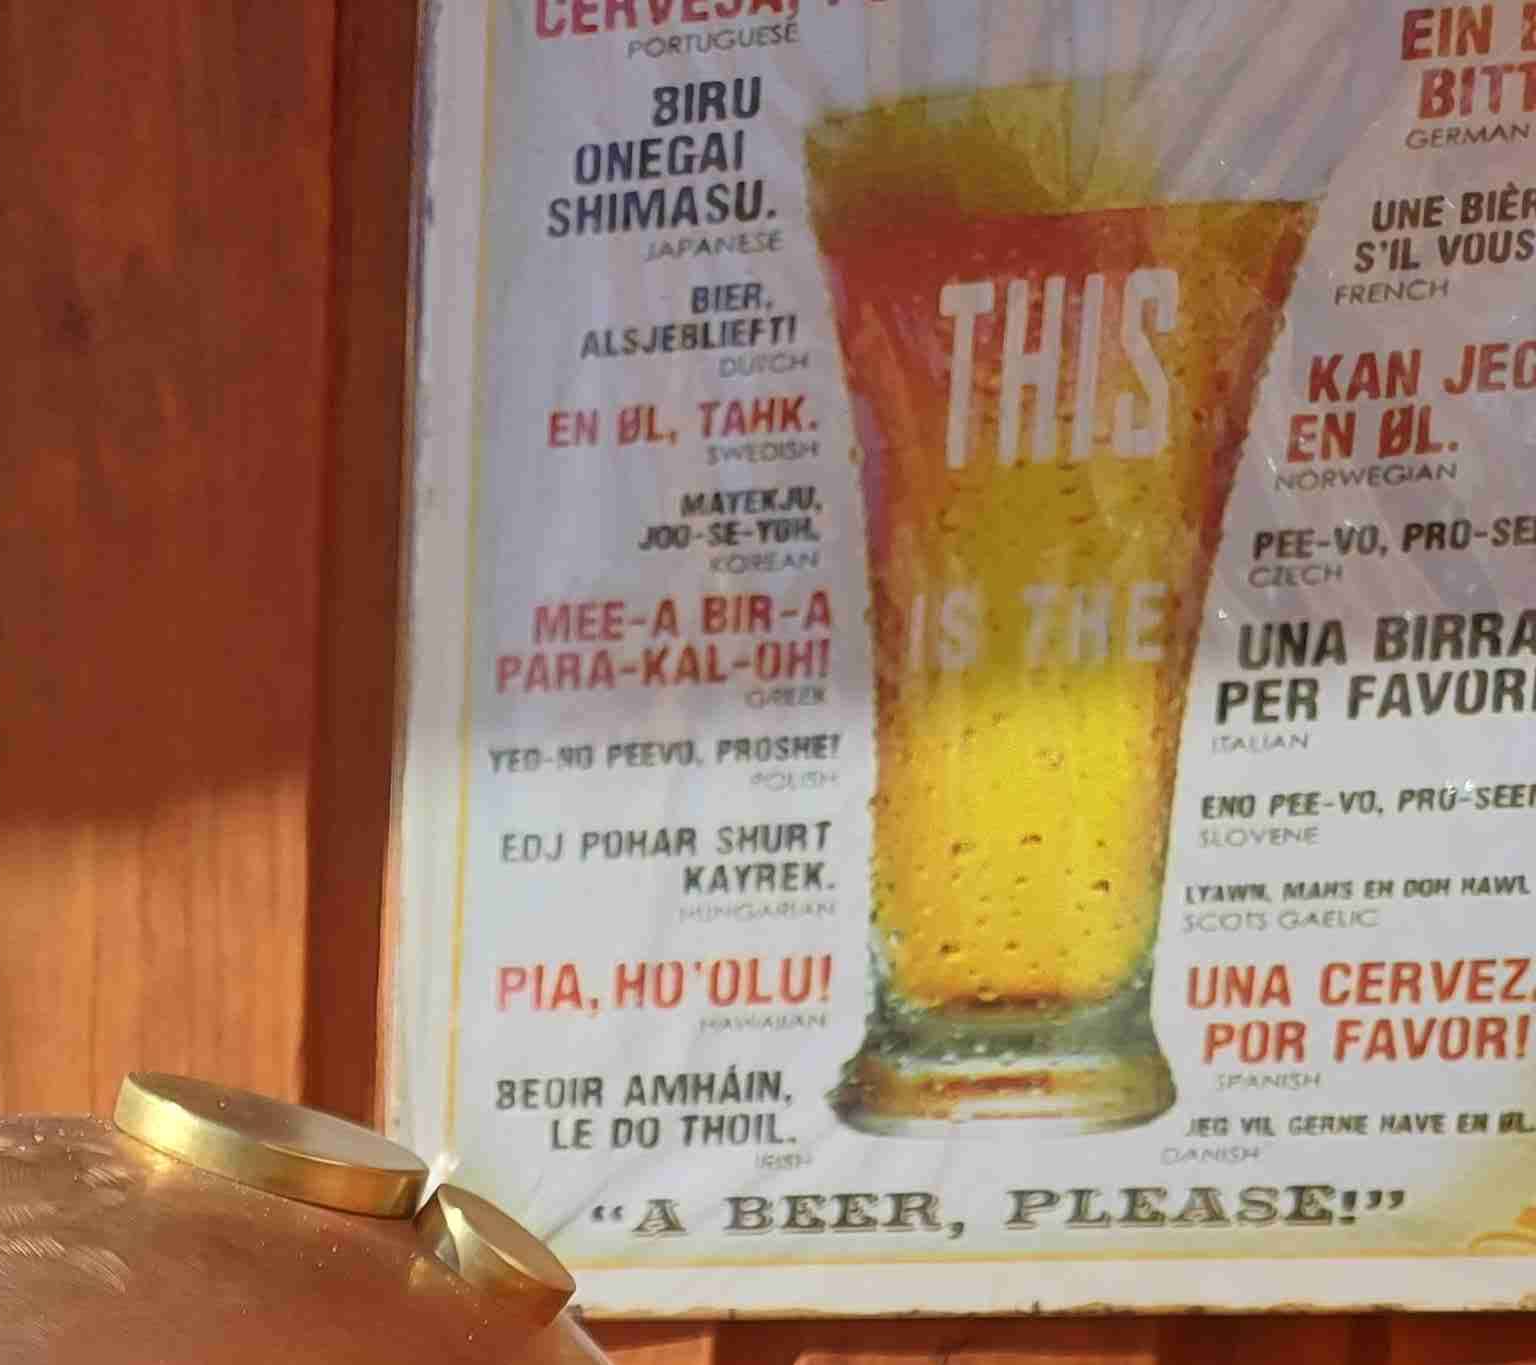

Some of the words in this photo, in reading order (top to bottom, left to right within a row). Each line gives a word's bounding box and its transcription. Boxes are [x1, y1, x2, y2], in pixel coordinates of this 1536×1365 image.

[536, 0, 799, 39] CERV,
[1400, 4, 1493, 60] EIN
[627, 23, 798, 59] PORTUGUESE
[652, 76, 762, 127] BIRU
[1405, 122, 1529, 150] GERMAN
[575, 130, 745, 185] ONEGAI
[547, 180, 777, 238] SHIMASU.
[1372, 195, 1445, 232] UNE
[644, 232, 784, 261] JAPANESE
[1354, 237, 1420, 273] S'IL
[1438, 229, 1536, 266] VOUS
[1335, 279, 1449, 304] FRENCH
[719, 352, 810, 378] DUTCH
[939, 268, 1179, 469] THIS
[1309, 349, 1421, 403] KAN
[547, 409, 599, 448] EN
[698, 395, 819, 438] TAHK.
[1287, 412, 1356, 463] EN
[1378, 404, 1458, 458] ØL.
[706, 441, 820, 466] SWEDISH
[1275, 463, 1457, 491] NORWEGIAN
[710, 551, 819, 575] KOREAN
[1248, 564, 1343, 588] CZECH
[532, 598, 680, 645] MEE-A
[700, 590, 833, 634] BIR-A
[906, 587, 980, 673] IS
[1026, 583, 1168, 670] THE
[1239, 620, 1347, 670] UNA
[1374, 609, 1536, 663] BIRRA
[494, 638, 831, 694] PARA-KAL-OH!
[744, 687, 826, 710] GREEK
[1216, 677, 1319, 726] PER
[1346, 668, 1536, 719] FAVOR
[1212, 733, 1308, 752] ITALIAN
[1201, 795, 1254, 819] ENO
[579, 828, 697, 861] POHAR
[716, 821, 832, 855] SHURT
[1200, 827, 1319, 847] SLOVENE
[682, 862, 837, 895] KAYREK.
[1183, 912, 1268, 933] SCOTS
[1278, 909, 1381, 931] GAELIC
[497, 963, 600, 1015] PIA,
[1188, 964, 1291, 1010] UNA
[1319, 957, 1536, 1007] CERVEZ
[1202, 1019, 1307, 1065] POR
[1333, 1014, 1532, 1064] FAVOR!
[495, 1077, 604, 1111] BEOIR
[624, 1065, 794, 1108] AMHÁIN,
[1216, 1073, 1321, 1091] SPANISH
[550, 1119, 592, 1150] LE
[611, 1117, 660, 1149] DO
[681, 1114, 798, 1147] THOIL.
[1161, 1146, 1259, 1166] DANISH
[724, 1189, 968, 1239] BEER,
